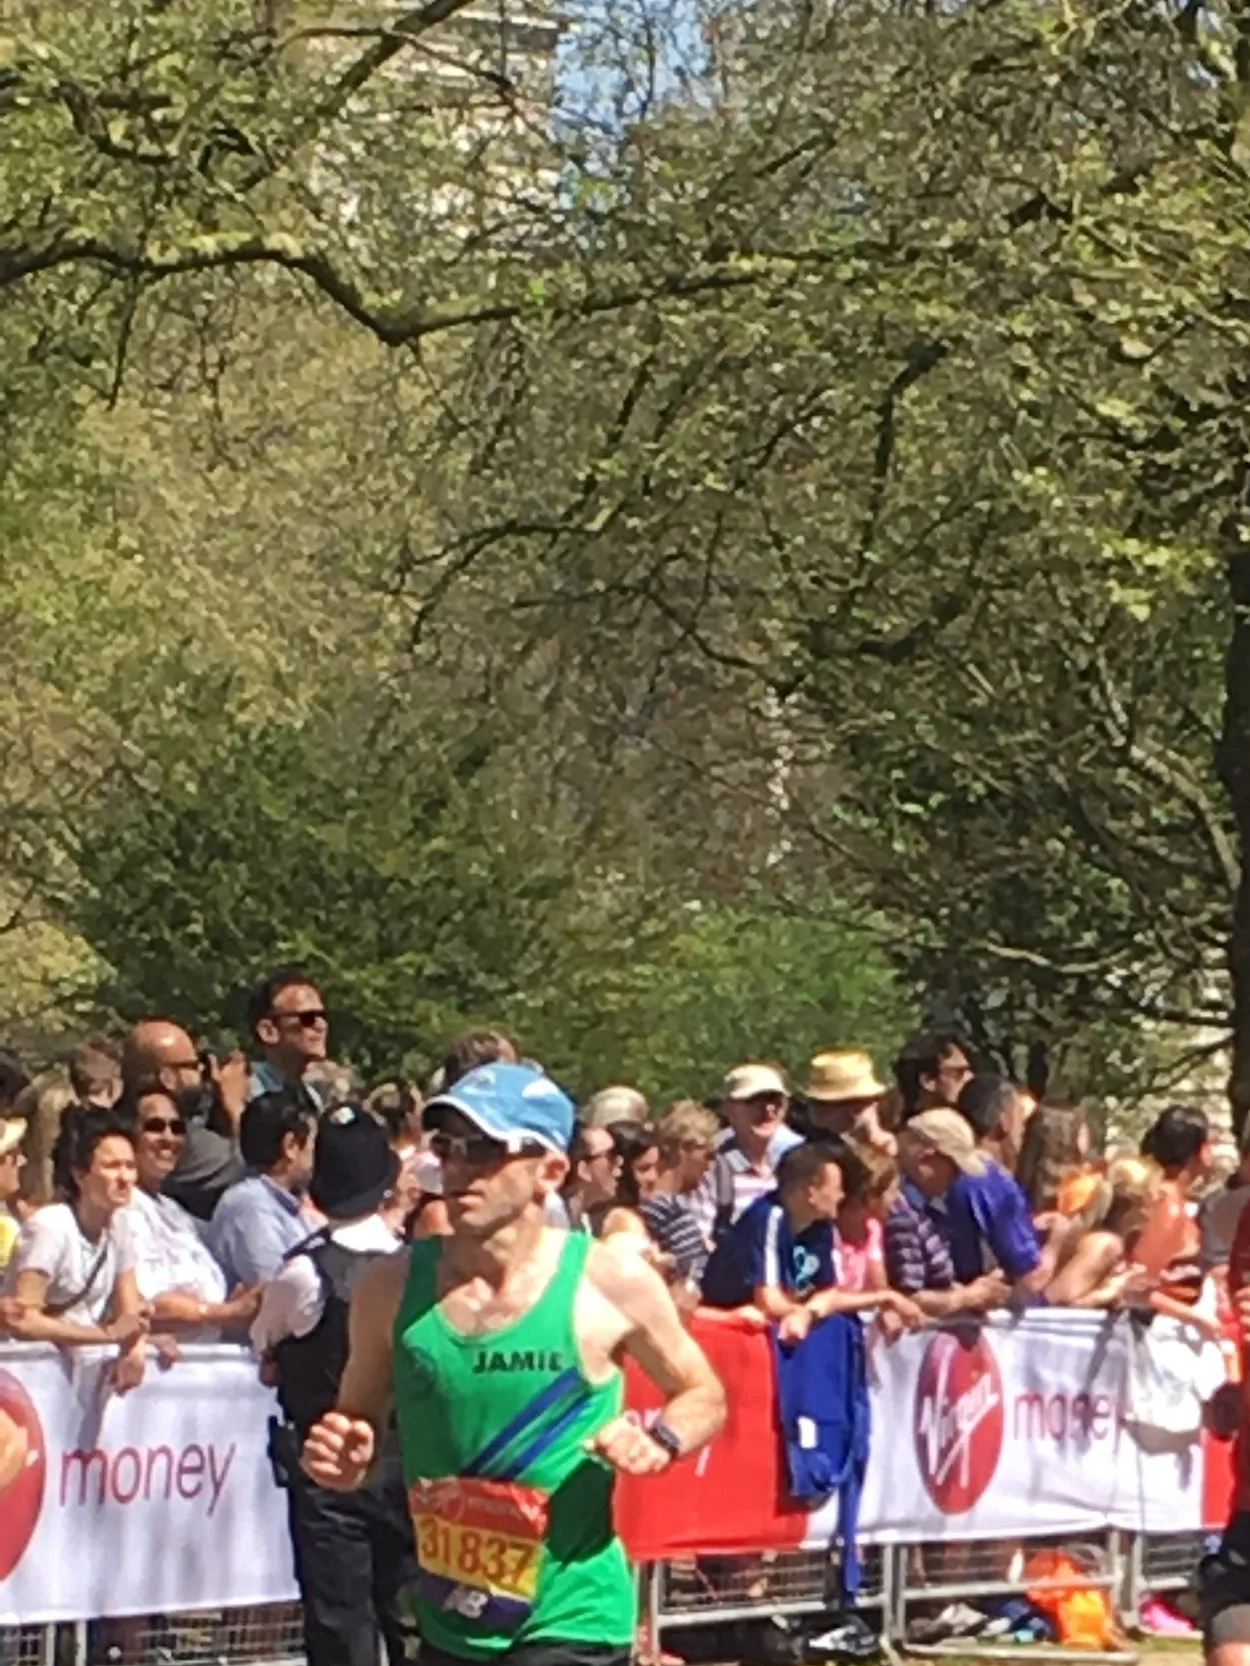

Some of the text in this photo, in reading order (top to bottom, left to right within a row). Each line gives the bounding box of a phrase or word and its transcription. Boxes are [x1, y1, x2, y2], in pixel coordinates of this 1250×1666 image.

[471, 1351, 564, 1374] JAMIE
[59, 1442, 236, 1517] money
[418, 1516, 537, 1585] 31837
